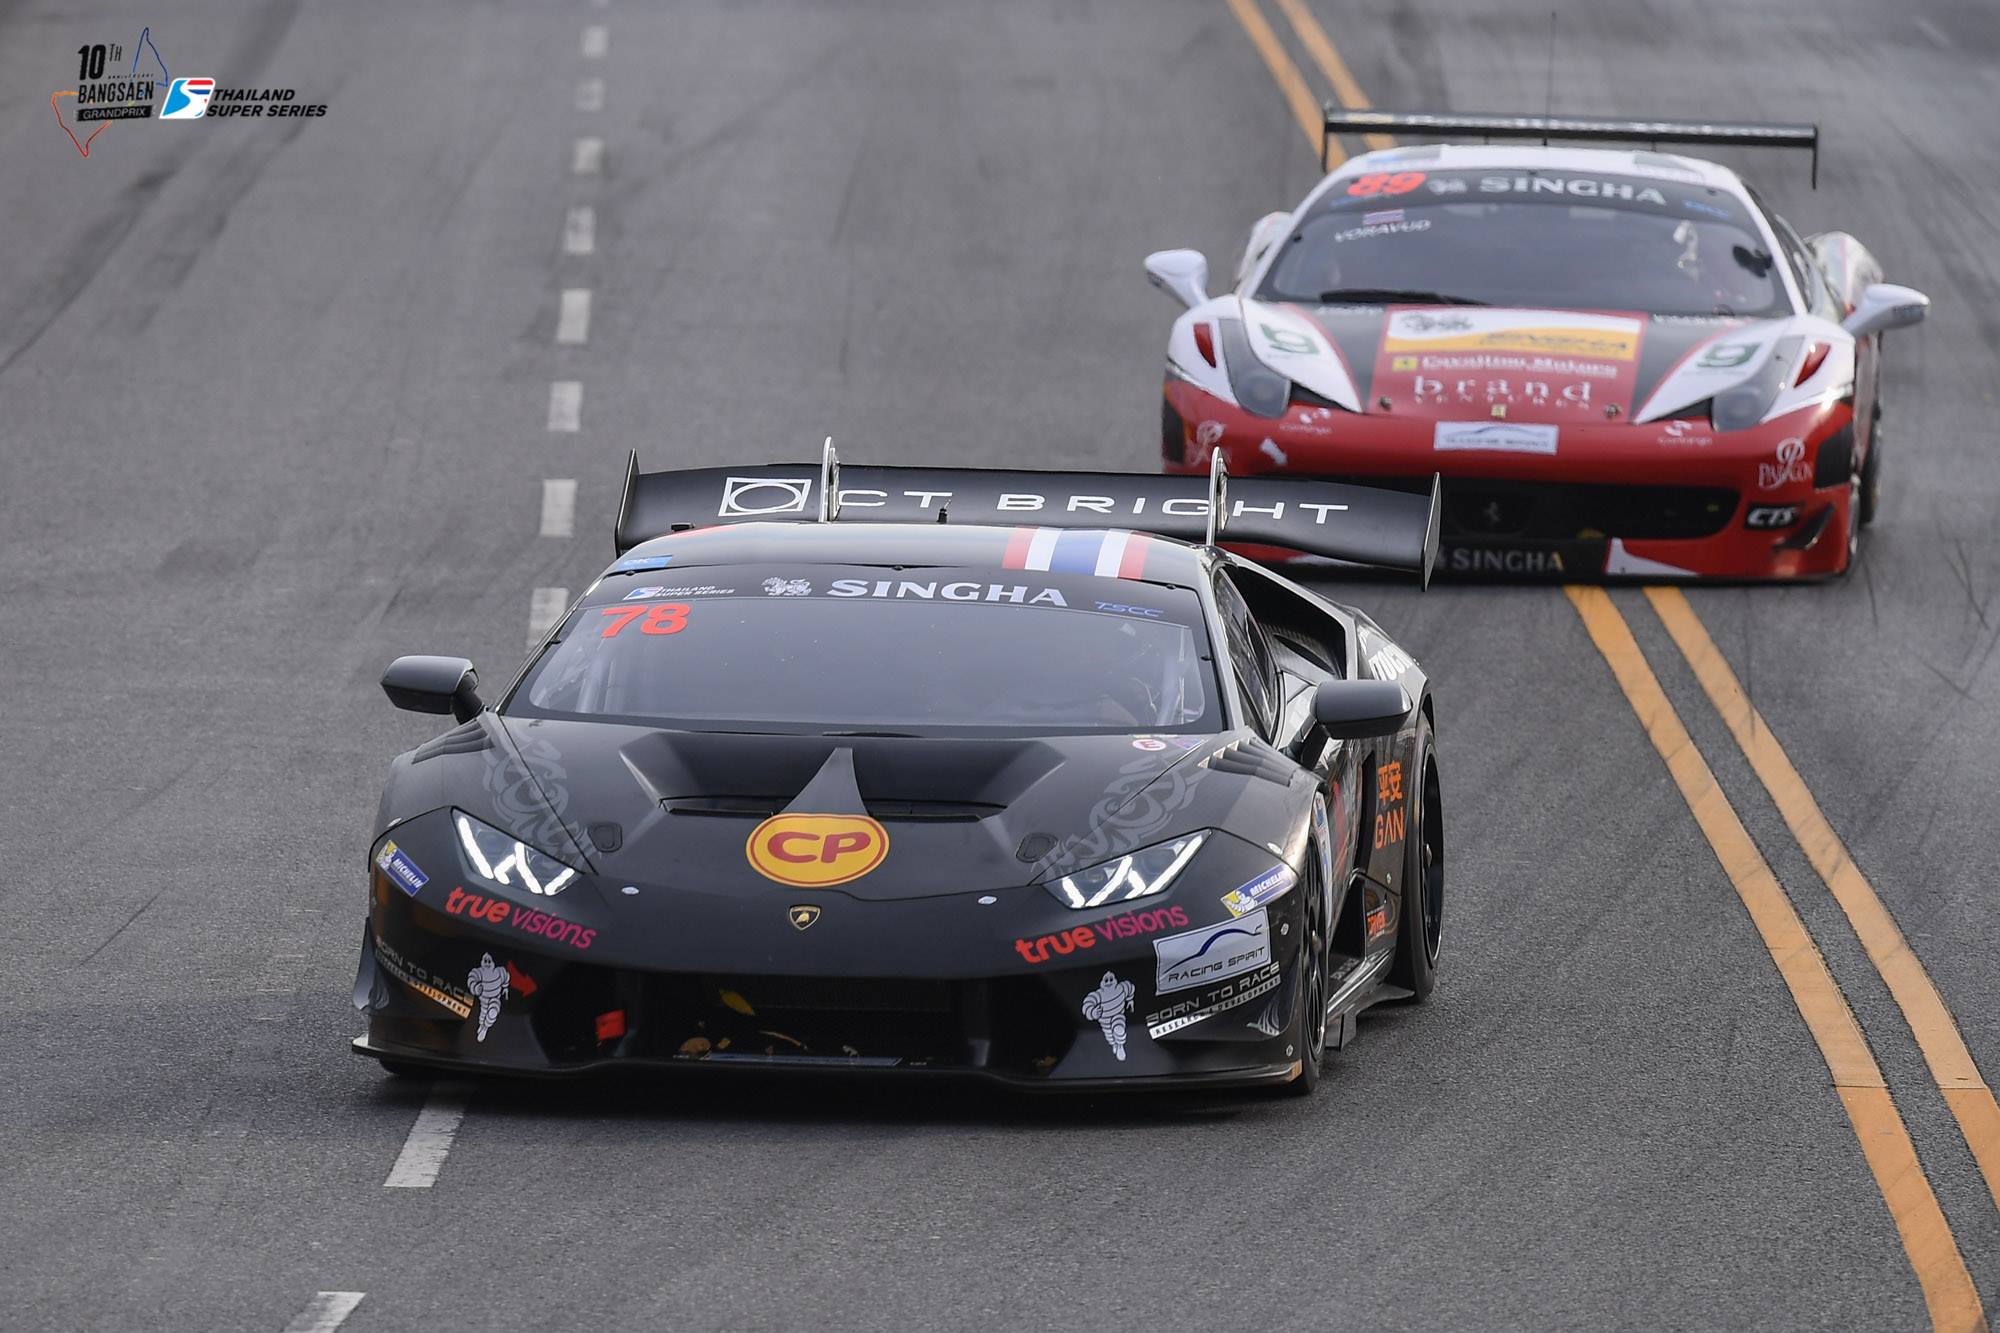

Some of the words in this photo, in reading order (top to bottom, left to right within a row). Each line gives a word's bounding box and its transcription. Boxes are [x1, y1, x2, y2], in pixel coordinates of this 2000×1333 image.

[1347, 171, 1427, 197] 89
[1479, 176, 1668, 206] SINGHA
[996, 493, 1349, 525] BRIGHT
[1450, 547, 1565, 573] SINGHA
[826, 579, 1068, 607] SINGHA
[1094, 600, 1164, 617] TSCC
[601, 603, 692, 638] 78
[767, 831, 872, 864] CP
[391, 857, 423, 889] MICHELIN
[446, 887, 511, 923] true
[513, 907, 597, 949] visions
[1015, 926, 1096, 964] true
[1094, 905, 1189, 942] visions
[1168, 961, 1223, 983] RACING
[1227, 946, 1266, 967] SPIRIT
[1145, 997, 1200, 1027] BORN
[1207, 985, 1234, 1002] TO
[1239, 960, 1280, 991] RACE
